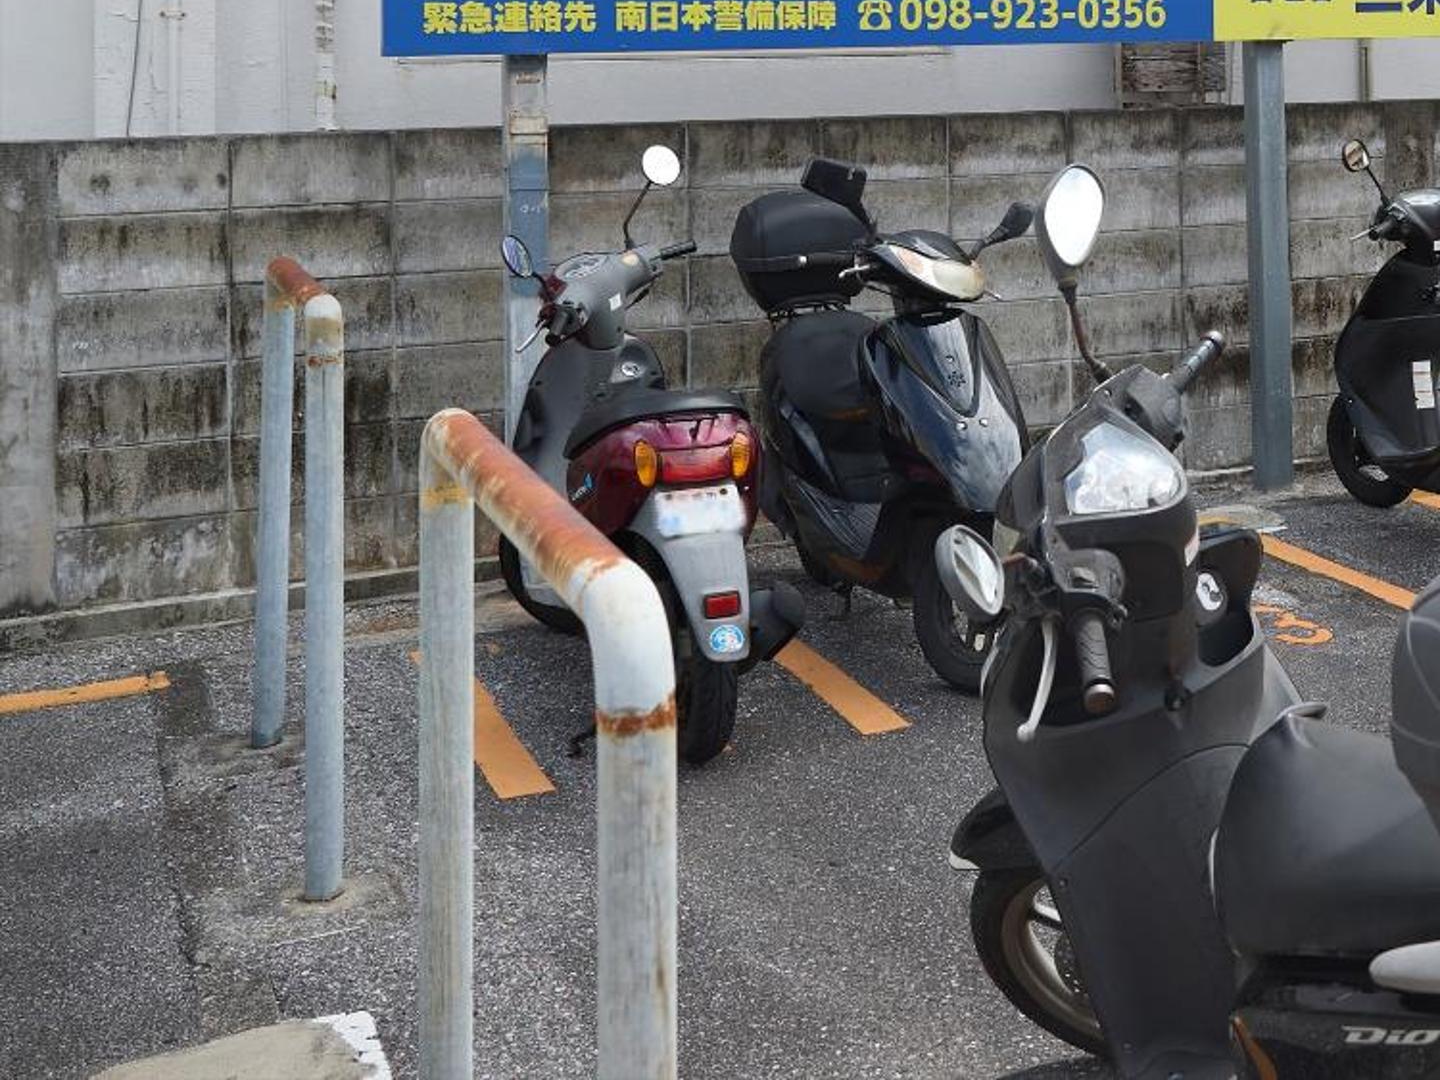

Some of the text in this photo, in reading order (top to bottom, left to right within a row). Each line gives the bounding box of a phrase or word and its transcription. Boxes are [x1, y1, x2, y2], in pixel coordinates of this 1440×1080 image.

[422, 1, 598, 35] 緊急連絡先
[615, 0, 838, 33] 南日本警備保障
